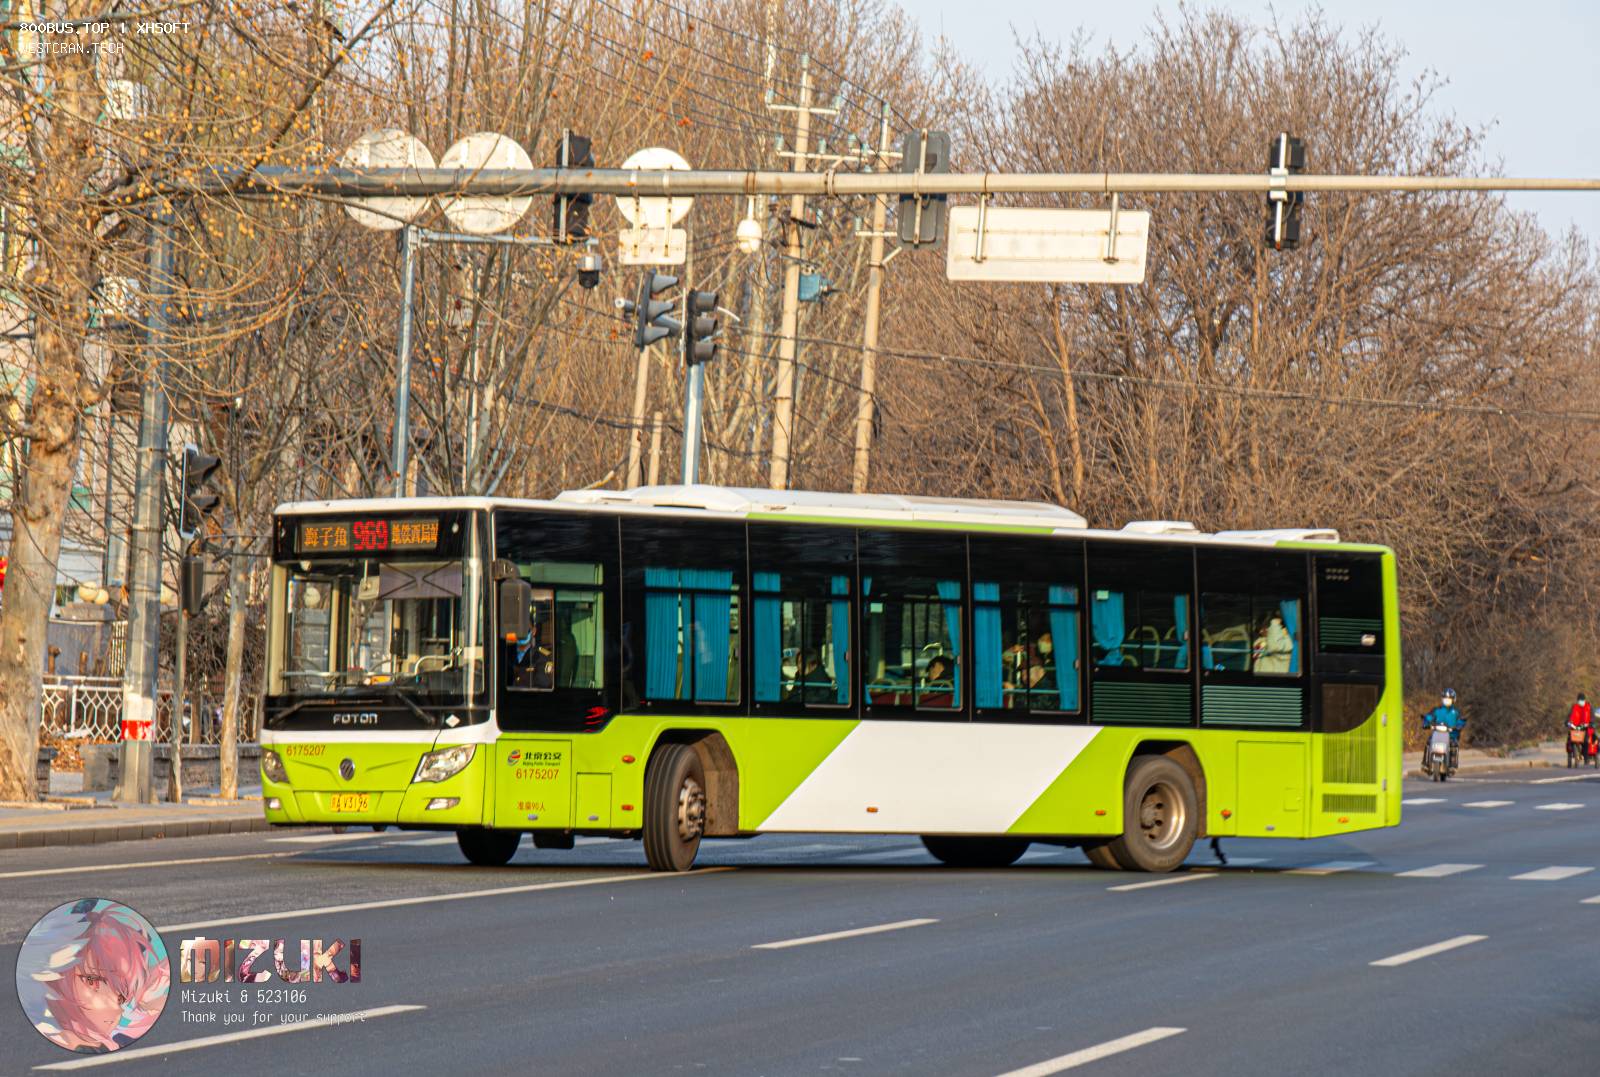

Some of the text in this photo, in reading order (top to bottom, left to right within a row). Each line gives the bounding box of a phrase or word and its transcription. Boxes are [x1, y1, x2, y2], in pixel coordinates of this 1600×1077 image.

[353, 520, 388, 550] 969
[333, 713, 378, 724] FOTON
[286, 745, 326, 756] 6175207
[515, 768, 559, 780] 6175207
